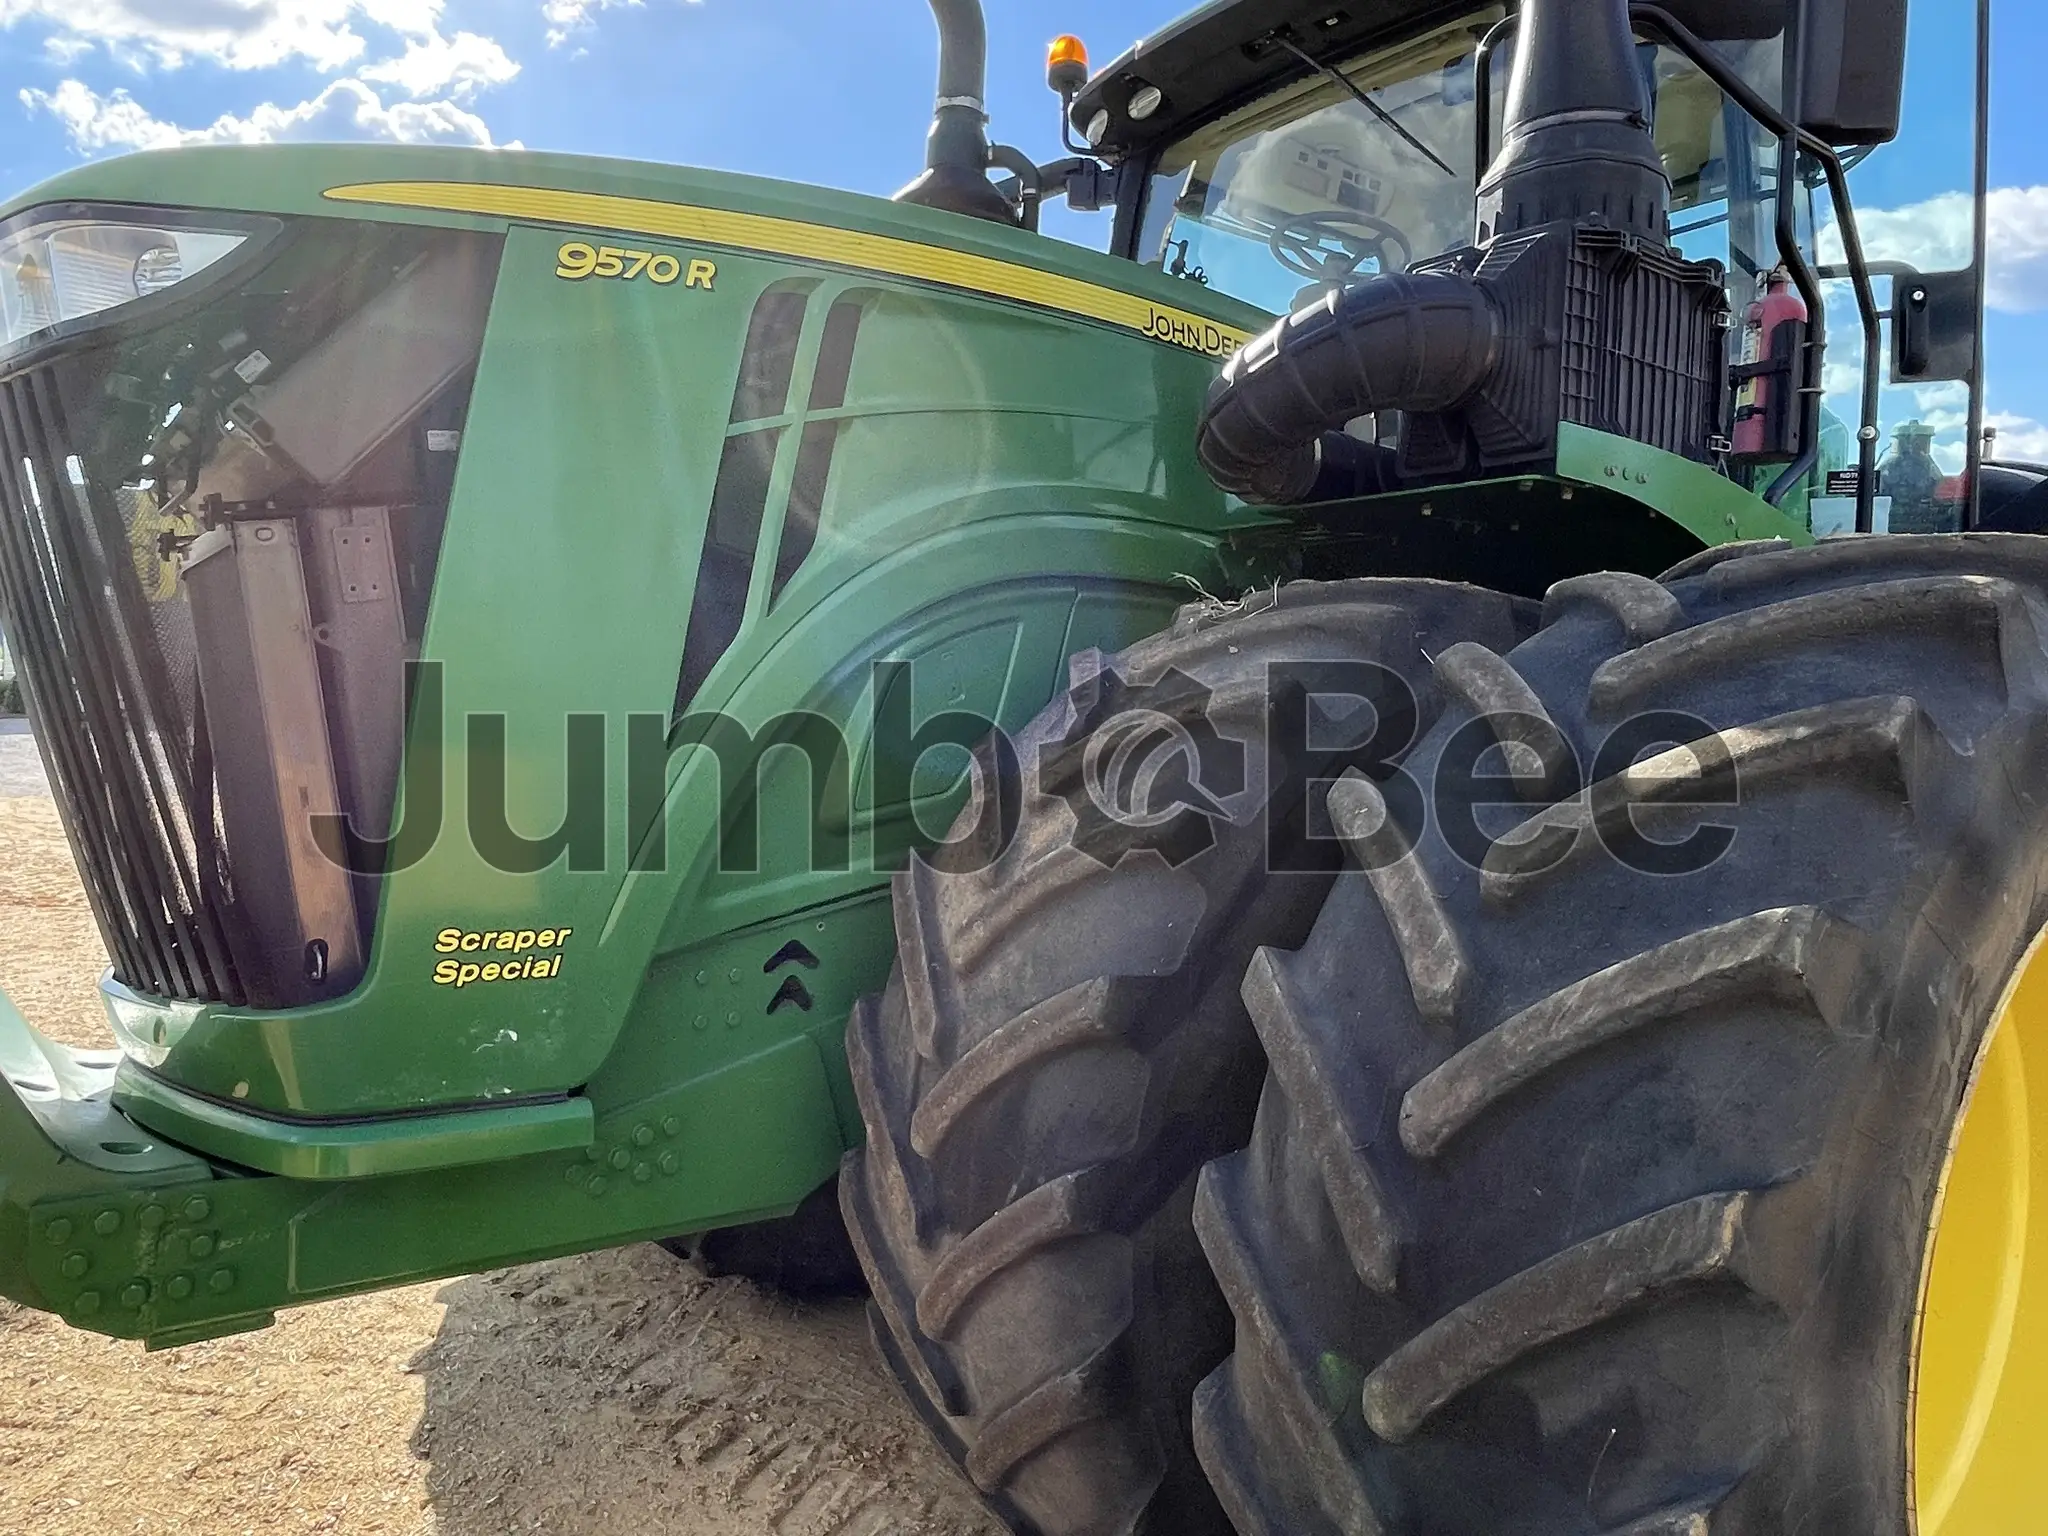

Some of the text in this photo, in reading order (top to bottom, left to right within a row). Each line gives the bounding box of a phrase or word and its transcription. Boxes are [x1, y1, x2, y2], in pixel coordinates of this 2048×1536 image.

[1142, 306, 1203, 351] JOHN
[433, 926, 574, 955] Scraper
[432, 953, 563, 989] Special
